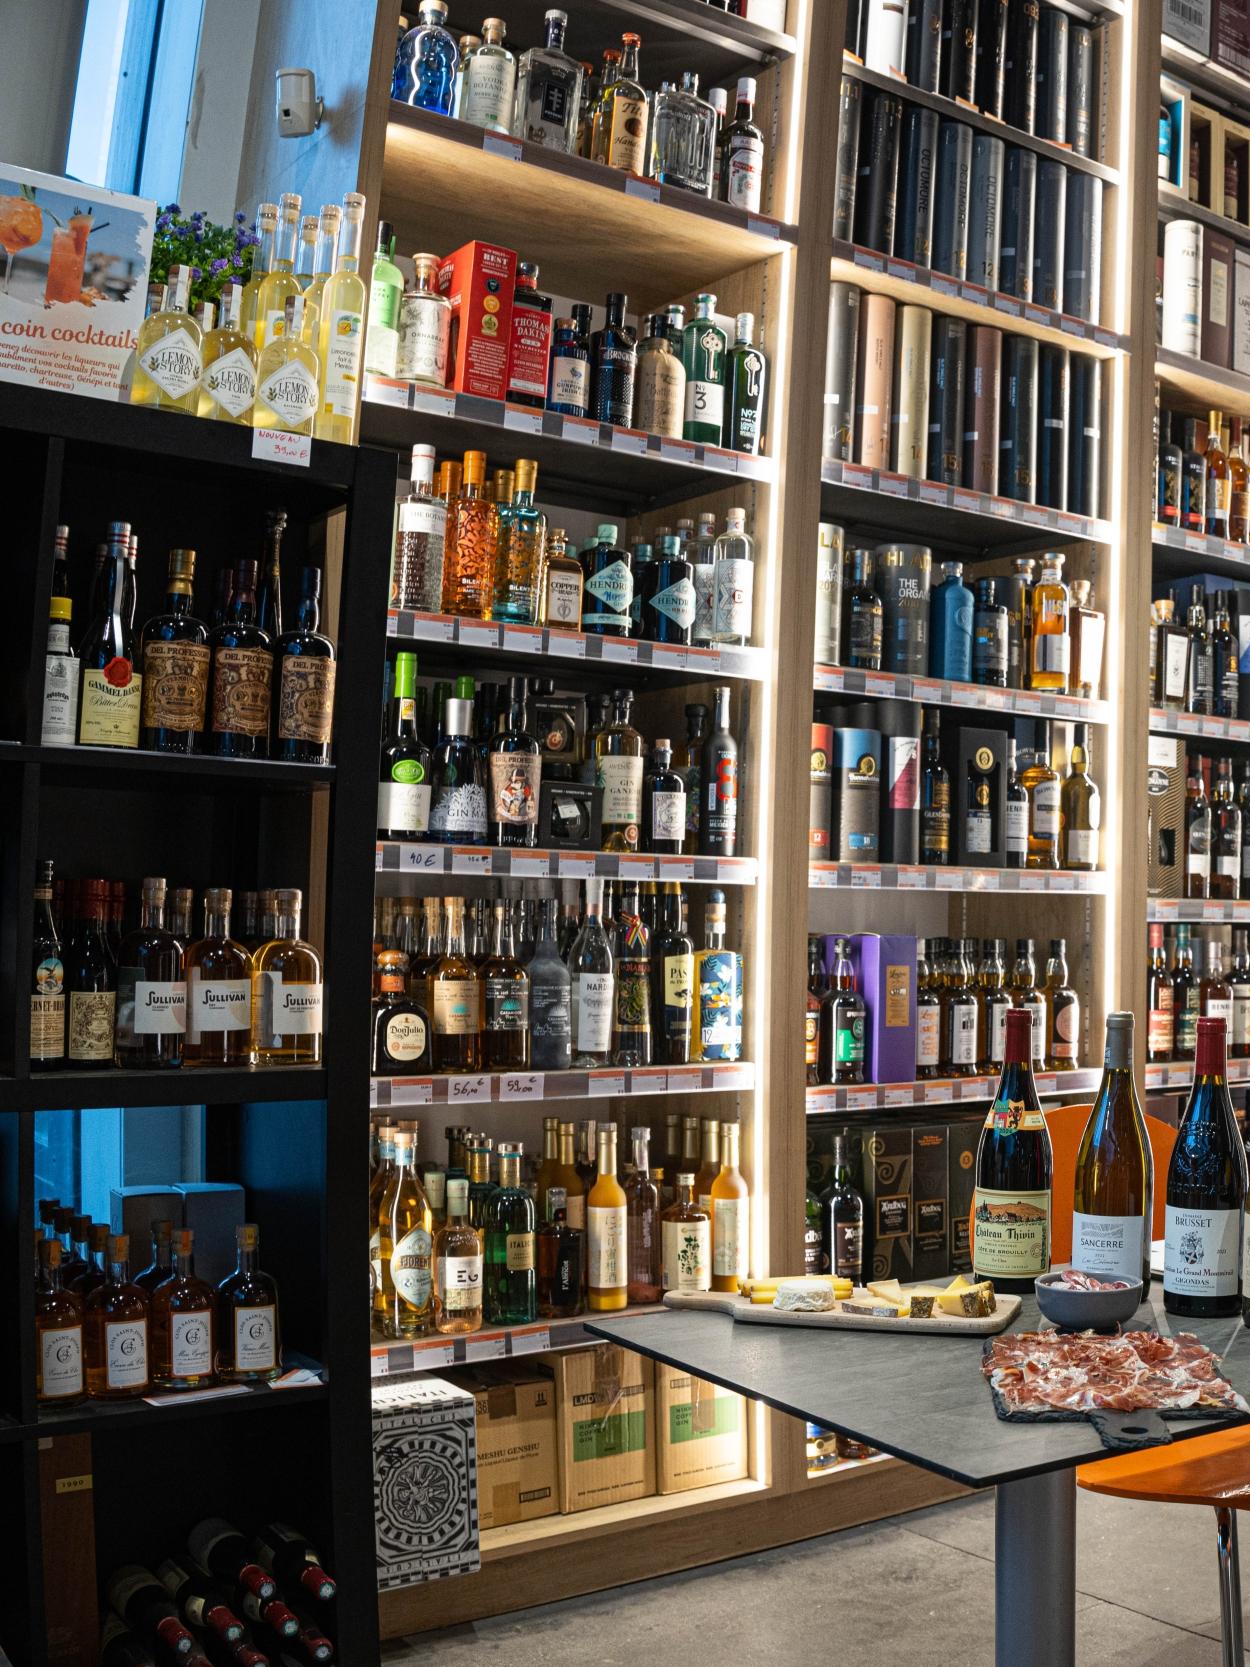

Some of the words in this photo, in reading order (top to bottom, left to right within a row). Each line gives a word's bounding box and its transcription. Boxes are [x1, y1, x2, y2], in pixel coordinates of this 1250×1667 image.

[918, 149, 931, 215] OCTOMORE
[957, 163, 968, 229] OCTOMORE
[984, 175, 997, 239] OCTOMORE
[483, 253, 508, 264] BEST
[1, 320, 47, 339] coin
[51, 324, 138, 350] cocktails
[517, 326, 545, 340] DAKIN
[21, 344, 60, 360] découvrir
[61, 352, 72, 361] les
[74, 354, 106, 368] liqueurs
[107, 361, 120, 372] qui
[161, 351, 194, 366] LEMON
[54, 360, 89, 374] cocktails
[89, 367, 118, 380] favoris
[160, 361, 192, 376] STORY
[221, 371, 250, 385] LEMON
[220, 381, 250, 395] STORY
[279, 381, 309, 397] LEMON
[557, 382, 585, 390] GUNPOW
[277, 392, 308, 405] STORY
[694, 391, 707, 410] 3
[551, 581, 580, 591] COPPER
[590, 580, 629, 591] HENDRI
[899, 578, 918, 589] THE
[899, 588, 930, 600] ORGAN
[152, 646, 165, 655] DEL
[224, 653, 240, 661] DEL
[293, 661, 308, 669] DEL
[88, 680, 122, 697] GAMMEL
[447, 809, 469, 818] GIN
[410, 852, 422, 864] 40
[424, 854, 436, 867] €
[586, 983, 612, 991] NARD
[145, 991, 185, 1007] SULLIVAN
[203, 989, 246, 1005] SULLIVAN
[283, 994, 321, 1009] SULLIVAN
[390, 1026, 405, 1035] Don
[404, 1026, 424, 1037] Julio
[703, 1029, 713, 1043] 12
[1175, 1215, 1212, 1228] BRUSSET
[976, 1225, 1002, 1239] Château
[1005, 1227, 1035, 1242] Thivin
[1081, 1237, 1124, 1249] SANCERRE
[998, 1248, 1028, 1256] BROUILLY
[1183, 1267, 1202, 1276] Grand
[1203, 1267, 1233, 1277] Montmirail
[1175, 1277, 1210, 1286] GIGONDAS
[380, 1413, 456, 1429] ITALICUS
[477, 1449, 507, 1462] MESHU
[507, 1442, 540, 1456] GENSHU
